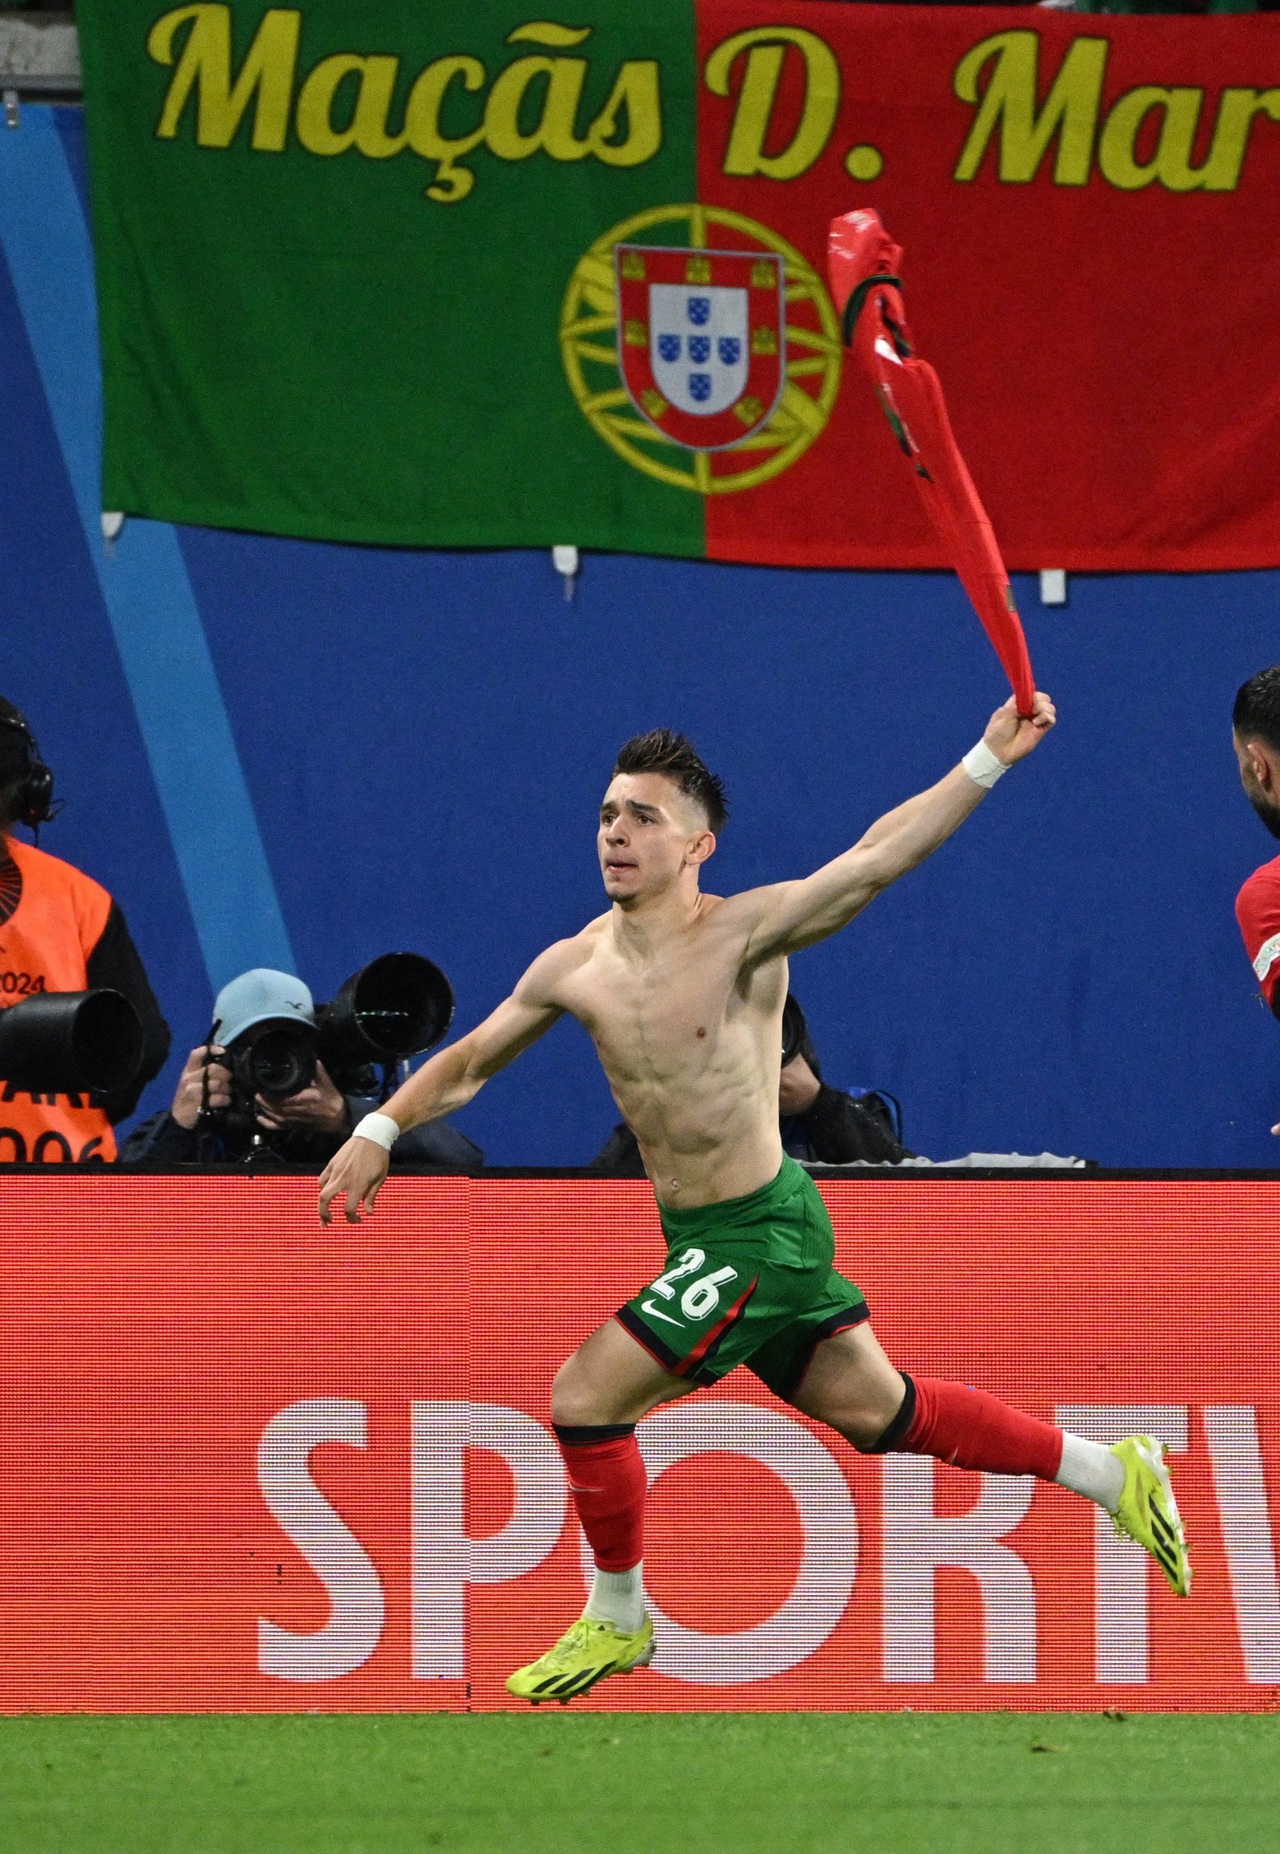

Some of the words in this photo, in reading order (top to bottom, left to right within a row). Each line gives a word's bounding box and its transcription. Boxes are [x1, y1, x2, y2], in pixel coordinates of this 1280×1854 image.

[147, 3, 663, 202] Maçãs
[705, 25, 883, 182] D.
[0, 971, 46, 995] 024
[650, 1248, 738, 1321] 26
